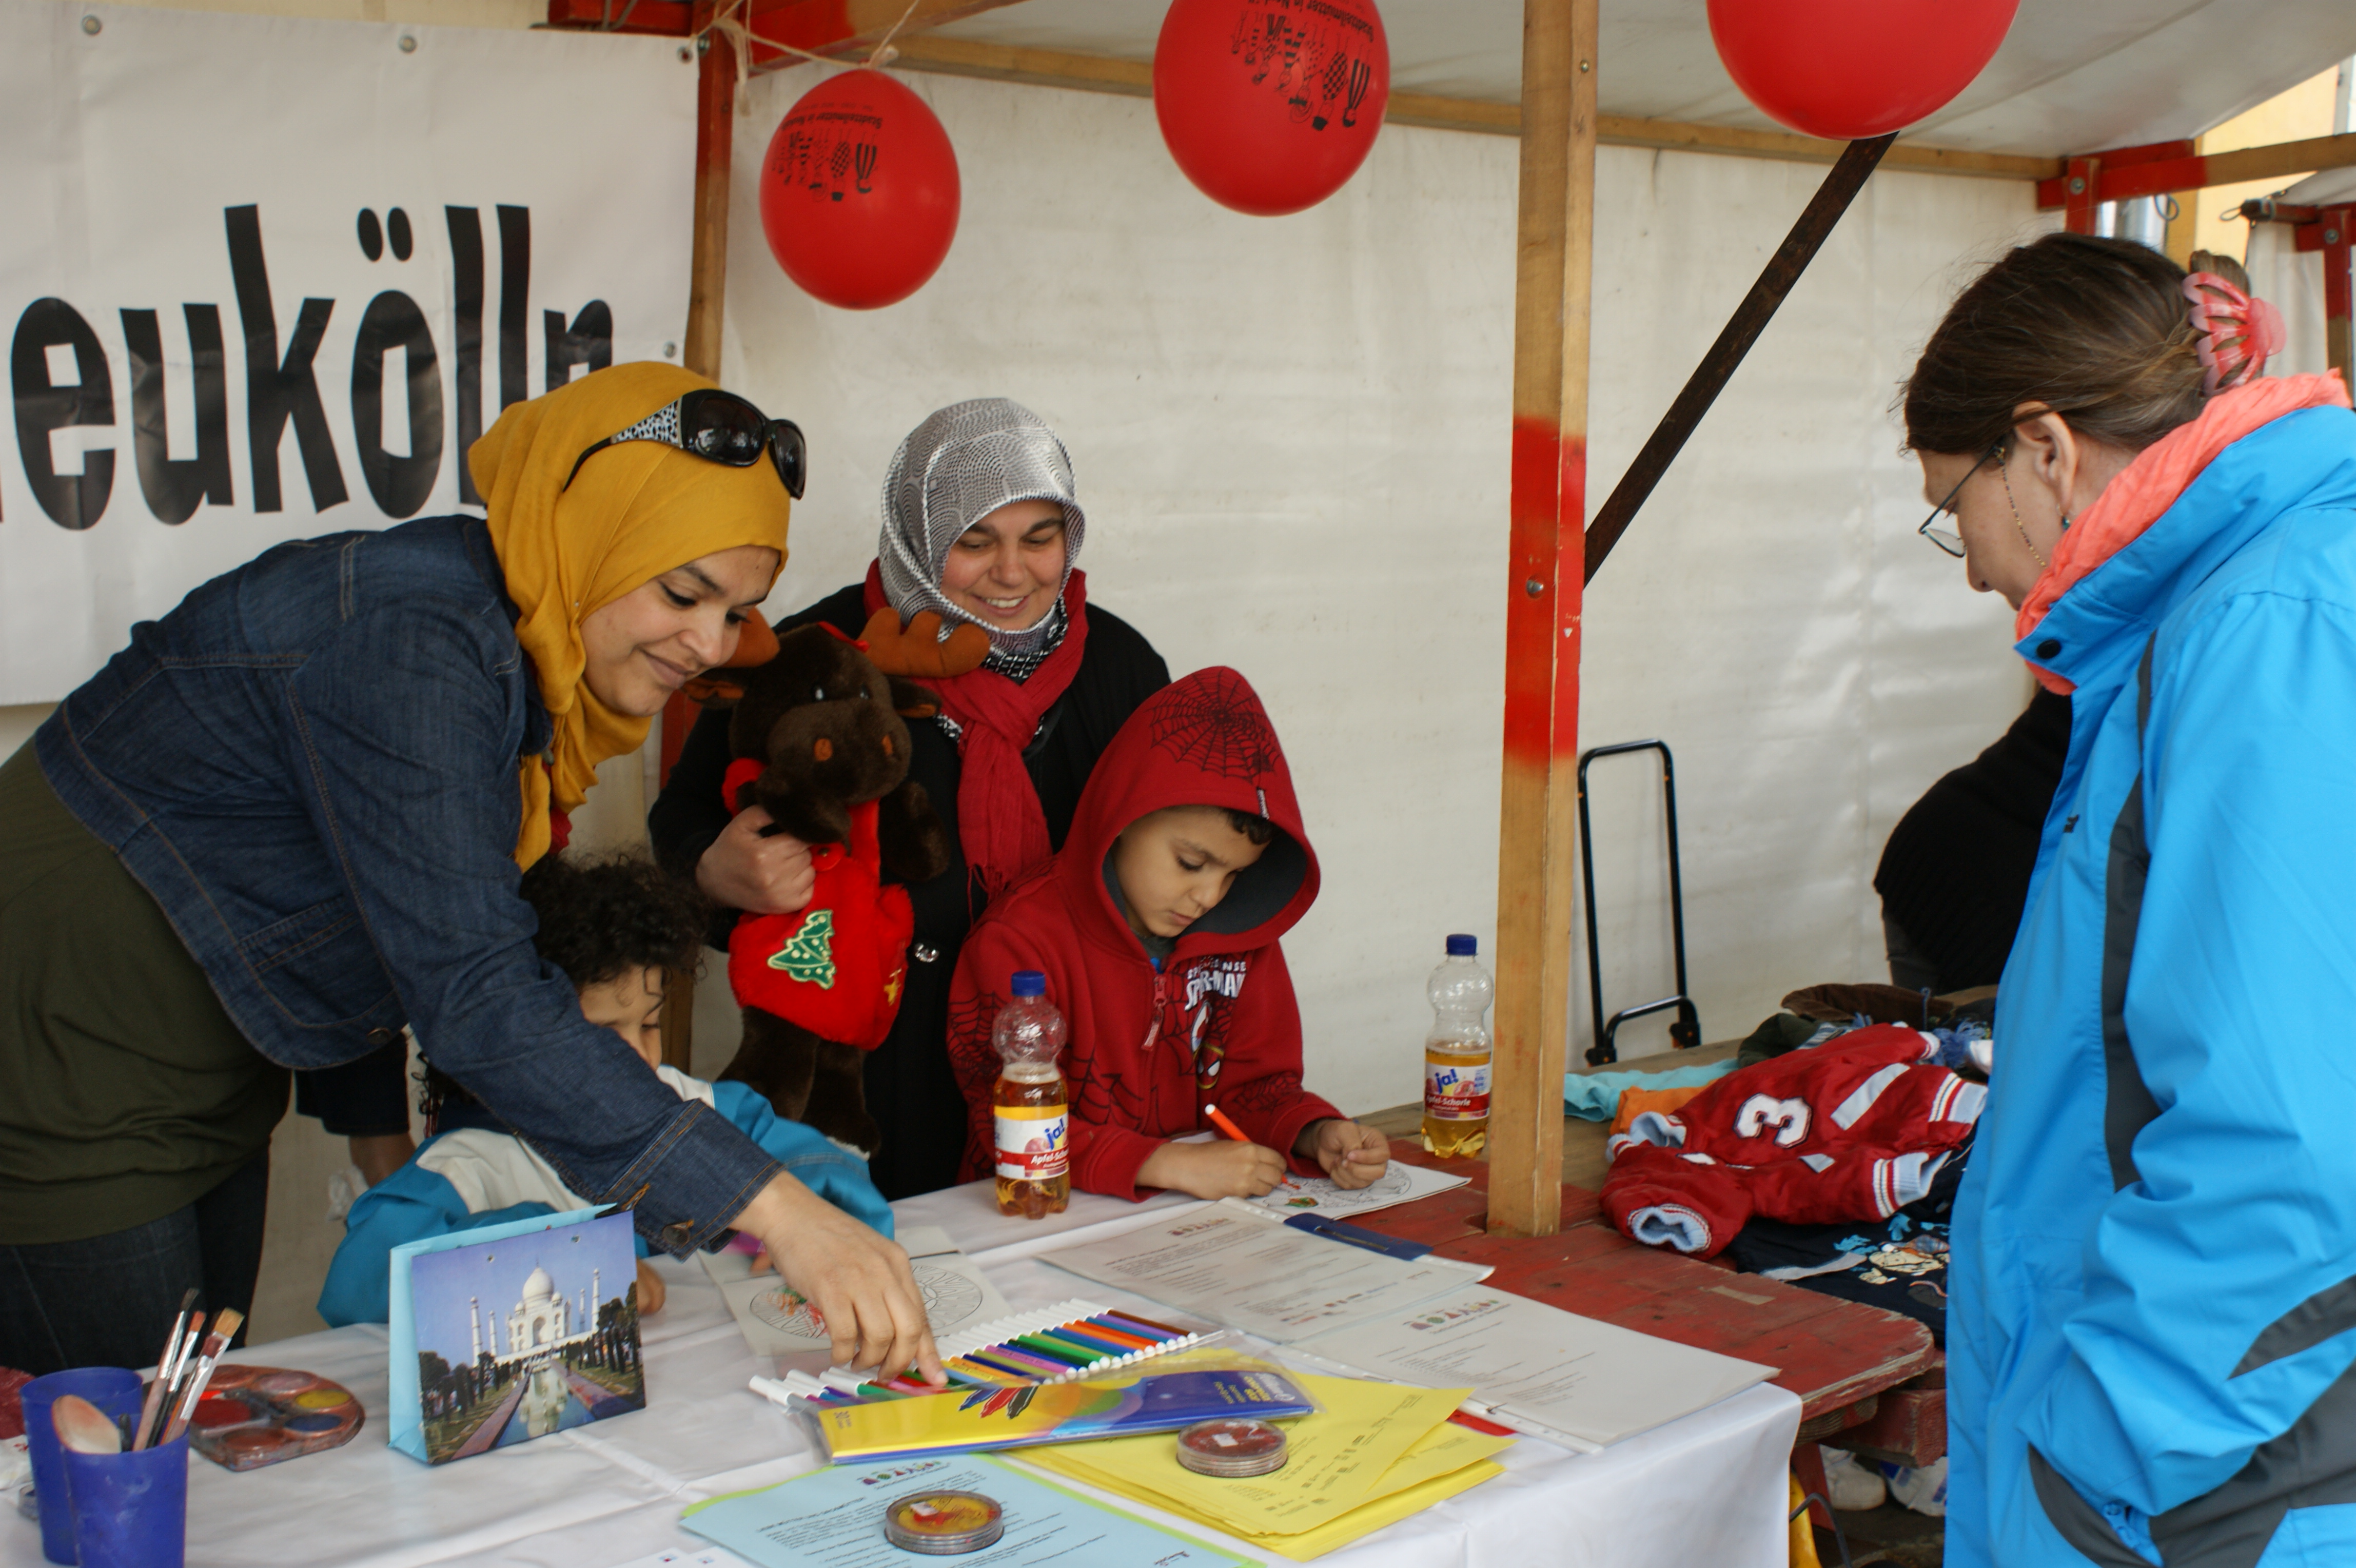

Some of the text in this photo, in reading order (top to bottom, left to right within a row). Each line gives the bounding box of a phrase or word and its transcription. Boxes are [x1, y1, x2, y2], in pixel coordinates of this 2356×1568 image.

[0, 203, 613, 531] euköll
[1434, 1068, 1459, 1094] ja!
[1044, 1118, 1065, 1151] ja!
[1733, 1092, 1813, 1149] 3
